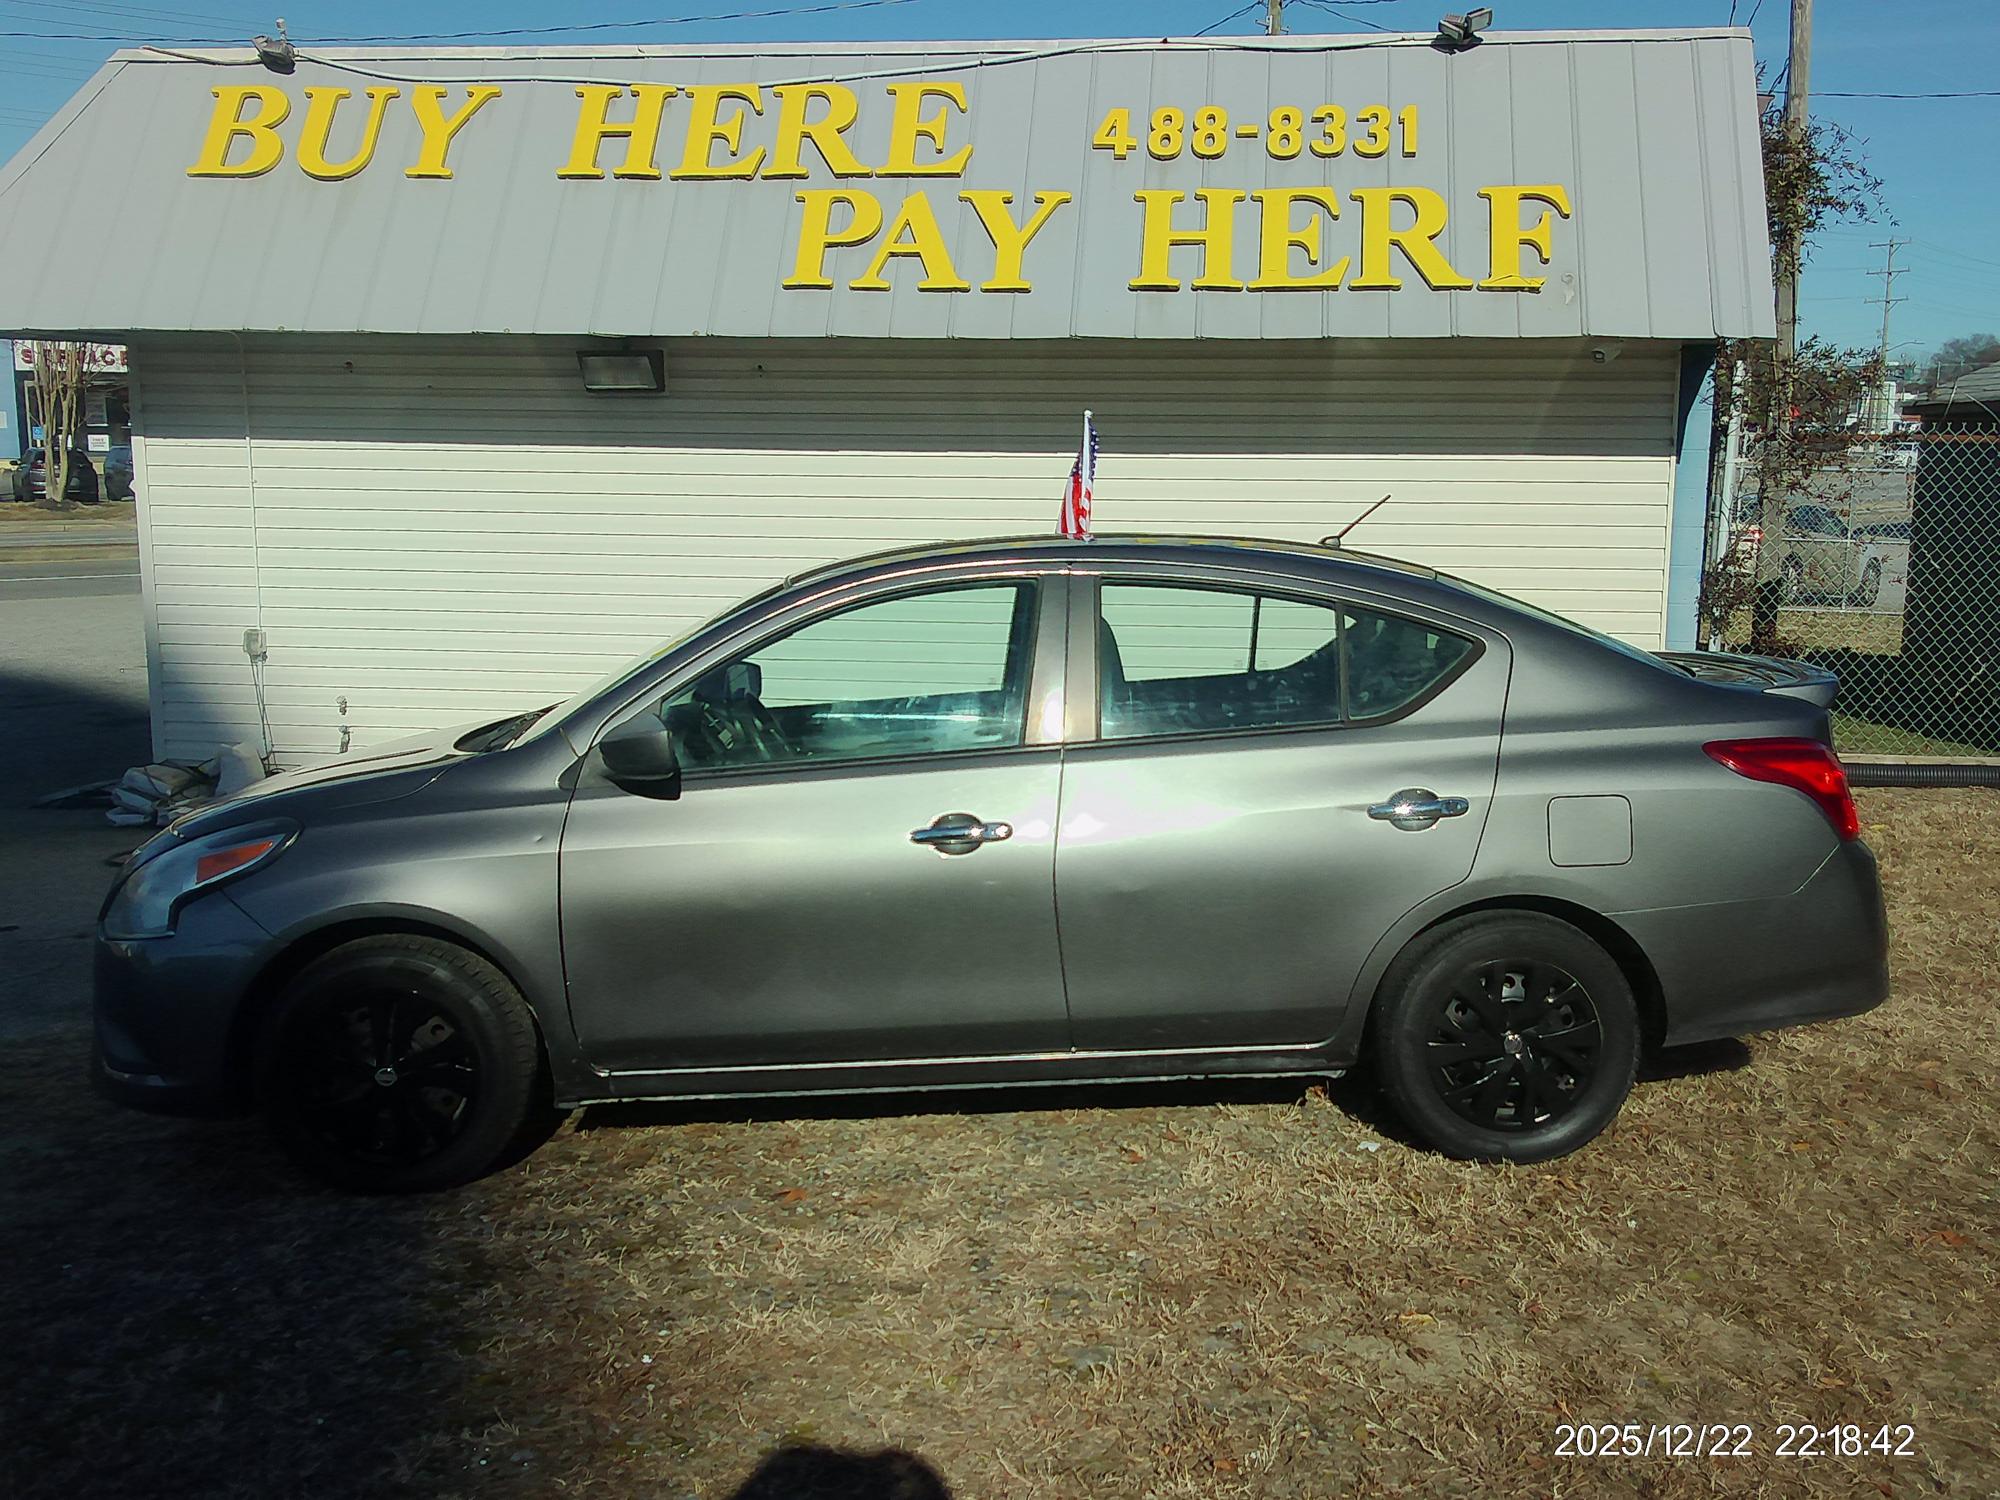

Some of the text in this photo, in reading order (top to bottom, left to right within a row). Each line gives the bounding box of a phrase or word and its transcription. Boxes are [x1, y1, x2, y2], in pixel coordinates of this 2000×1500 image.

[187, 82, 974, 180] BUY HERE
[1093, 103, 1418, 159] 488-8331
[783, 188, 1073, 292] PAY
